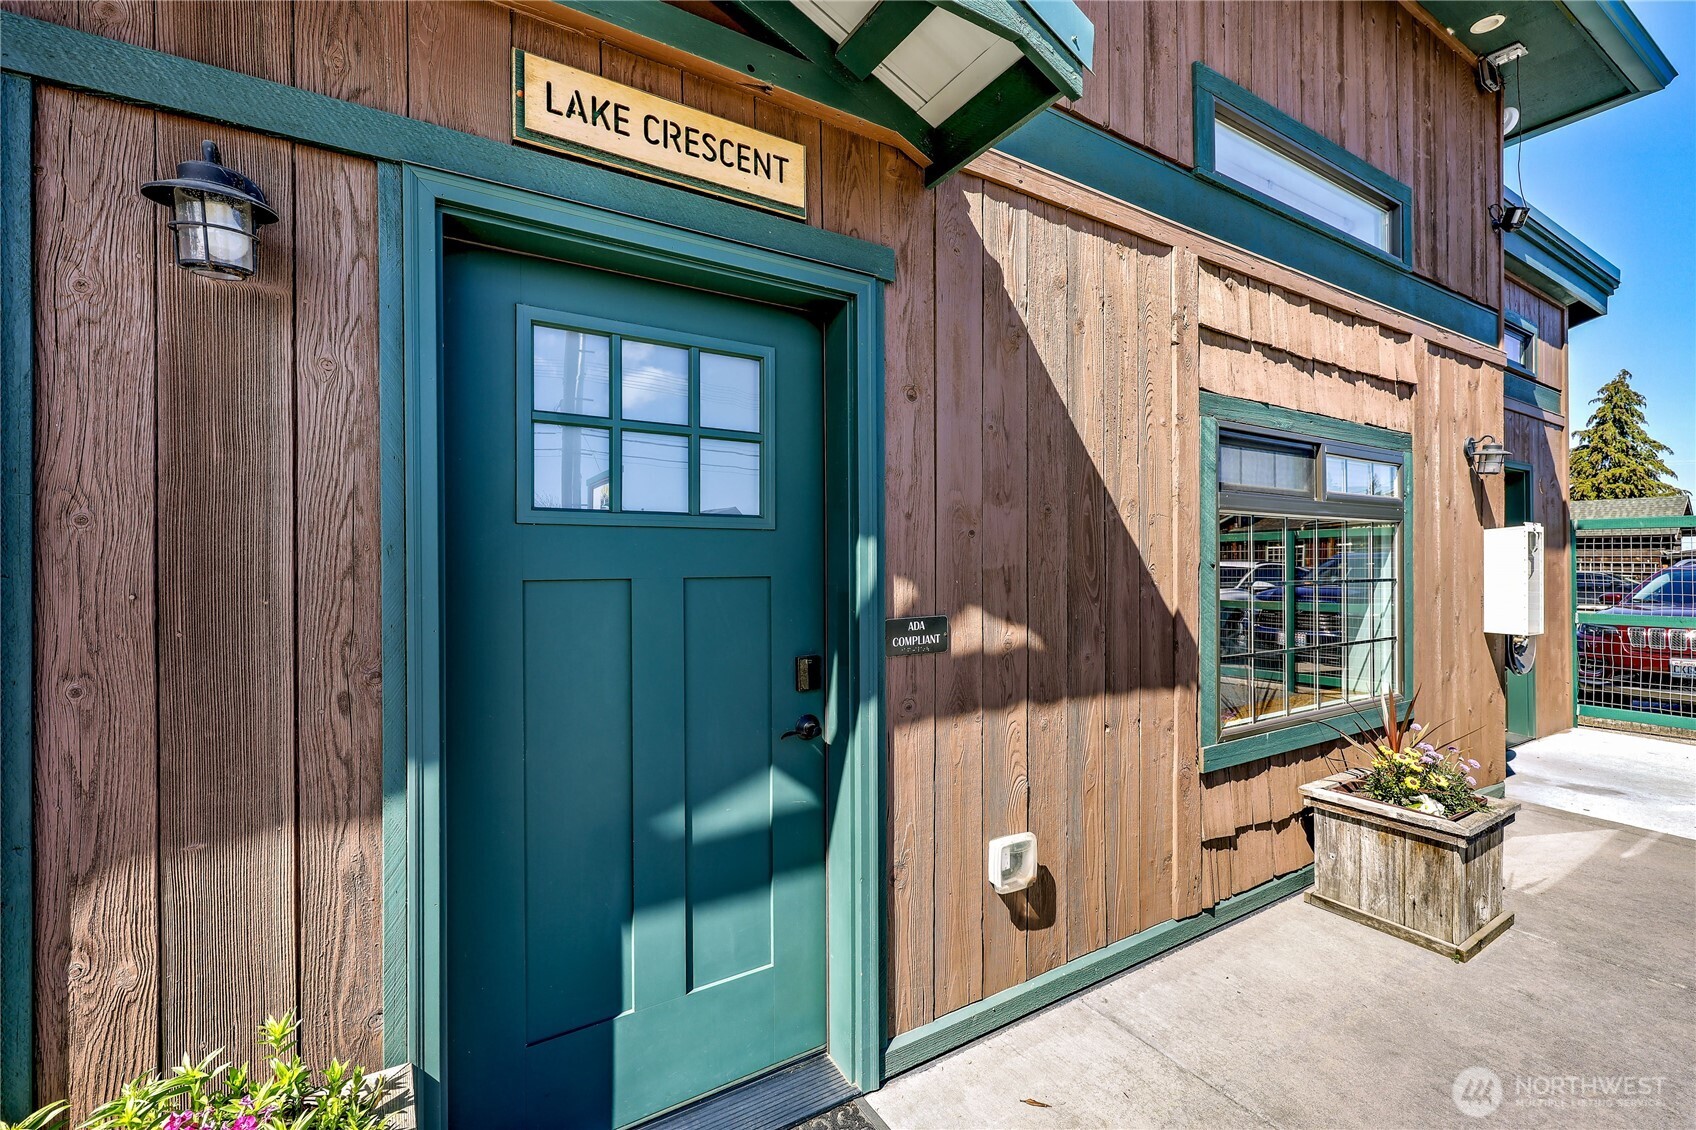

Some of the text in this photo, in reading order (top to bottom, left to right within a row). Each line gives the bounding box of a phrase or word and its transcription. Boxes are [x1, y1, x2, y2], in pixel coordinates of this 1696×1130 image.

[546, 80, 790, 184] LAKE CRESCENT
[908, 621, 925, 631] ADA
[892, 633, 941, 648] COMPLIANT
